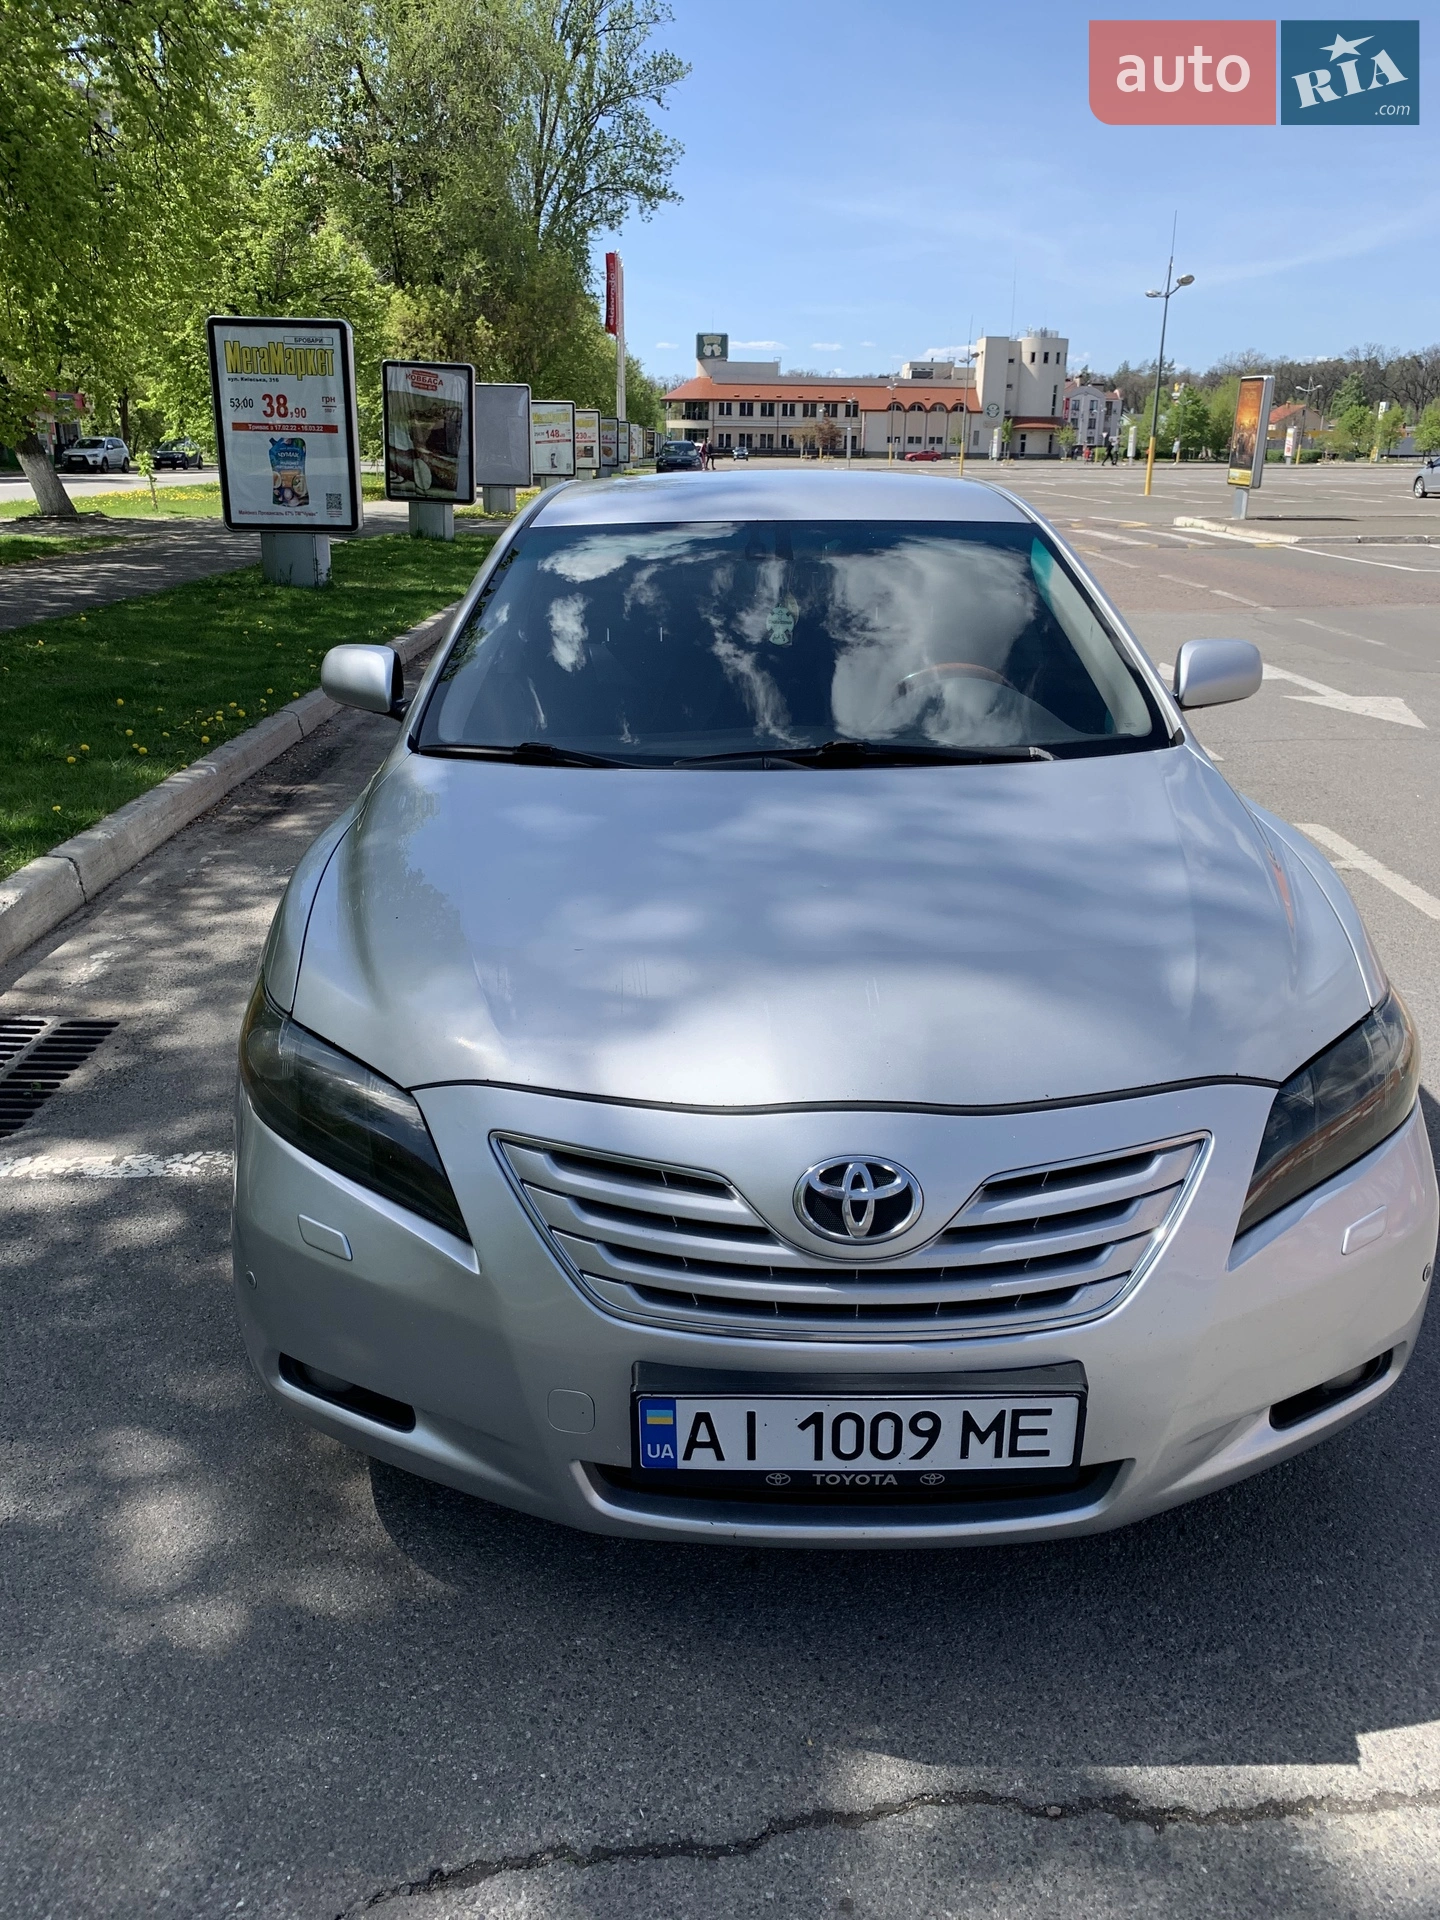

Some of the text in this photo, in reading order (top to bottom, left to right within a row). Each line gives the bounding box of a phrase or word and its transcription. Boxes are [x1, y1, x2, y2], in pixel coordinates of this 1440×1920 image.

[224, 340, 334, 381] МегаМаркет
[405, 373, 444, 386] КОВБАСА
[229, 393, 307, 419] 53,00 38,90
[321, 396, 336, 406] грн
[277, 451, 300, 459] ЧУМАК
[682, 1408, 1053, 1462] AI 1009 ME
[647, 1443, 675, 1460] UA
[811, 1473, 899, 1486] TOYOTA
